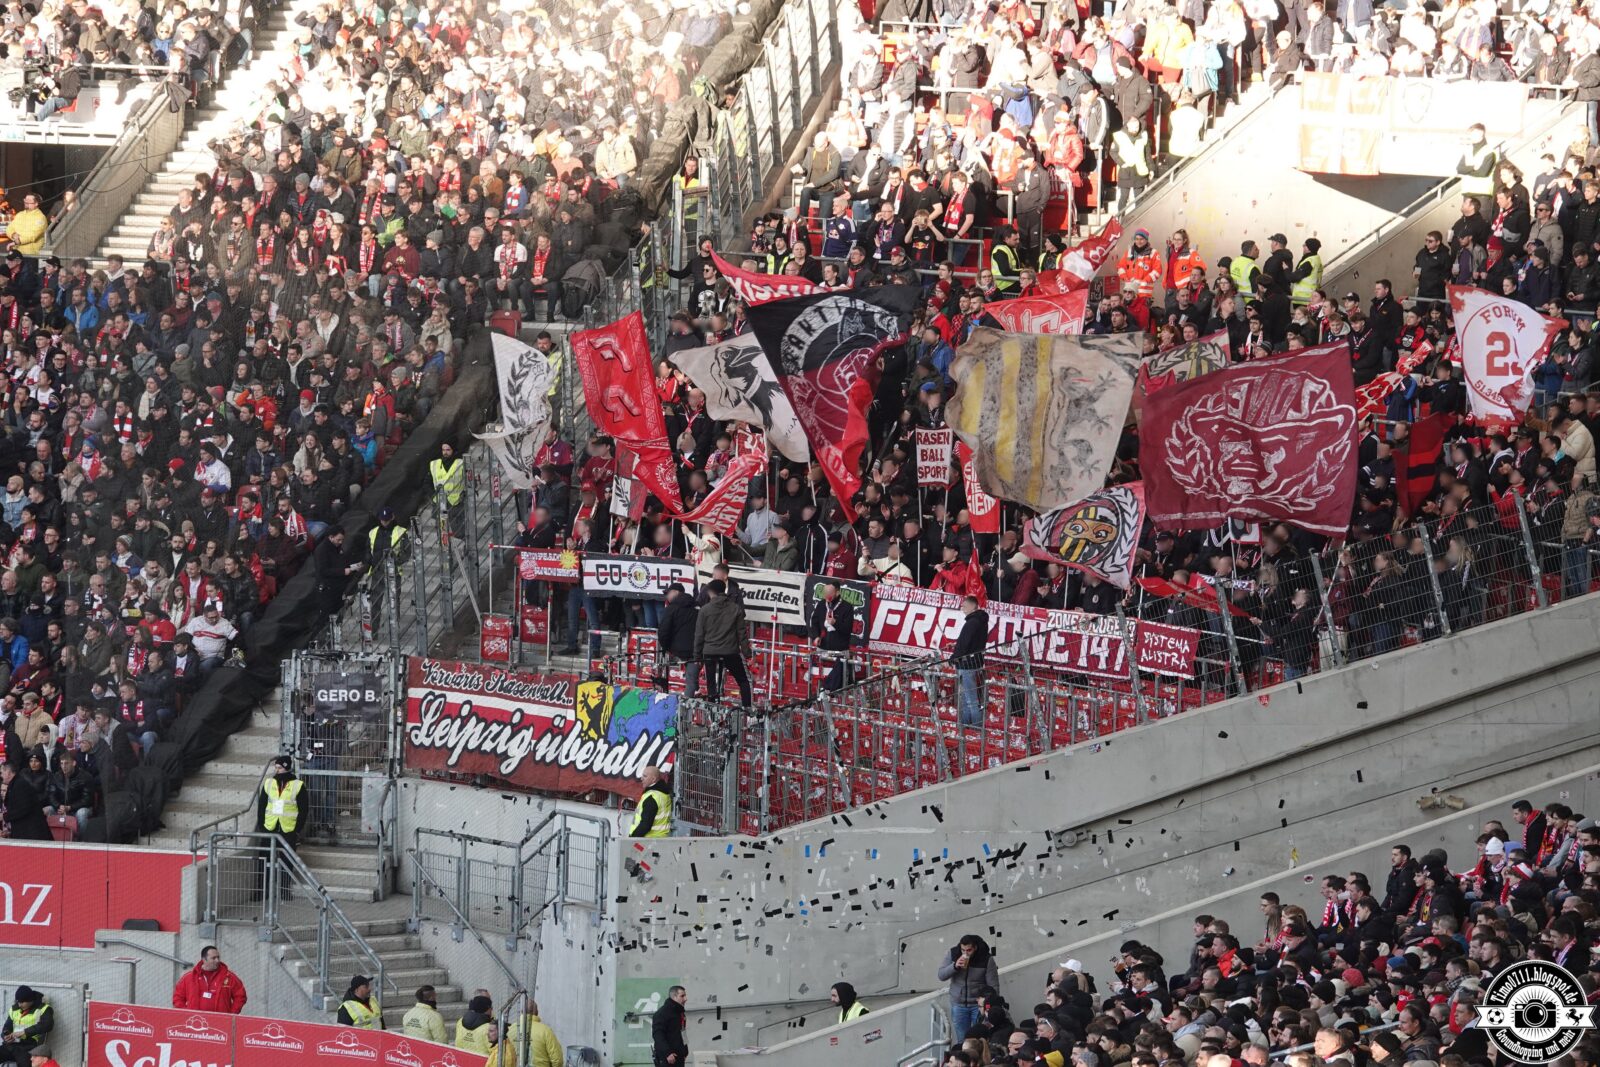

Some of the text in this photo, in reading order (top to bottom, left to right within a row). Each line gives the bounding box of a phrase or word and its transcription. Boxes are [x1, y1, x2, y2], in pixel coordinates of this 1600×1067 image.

[1480, 305, 1527, 332] FORUM
[916, 431, 950, 445] RASEN
[921, 448, 945, 462] BALL
[918, 466, 948, 479] SPORT
[1048, 611, 1078, 630] ZONE
[984, 614, 1069, 663] ZONE
[1077, 635, 1129, 672] 147
[1141, 649, 1188, 671] ALISTRA
[421, 660, 482, 690] Vorwärts
[317, 689, 380, 702] GERO B.
[411, 690, 534, 776] Leipzig
[95, 1021, 152, 1035] Schwarzwaldmilch
[168, 1029, 226, 1042] Schwarzwaldmilch
[245, 1036, 302, 1050] Schwarzwaldmilch
[318, 1044, 376, 1058] Schwarzwaldmilch
